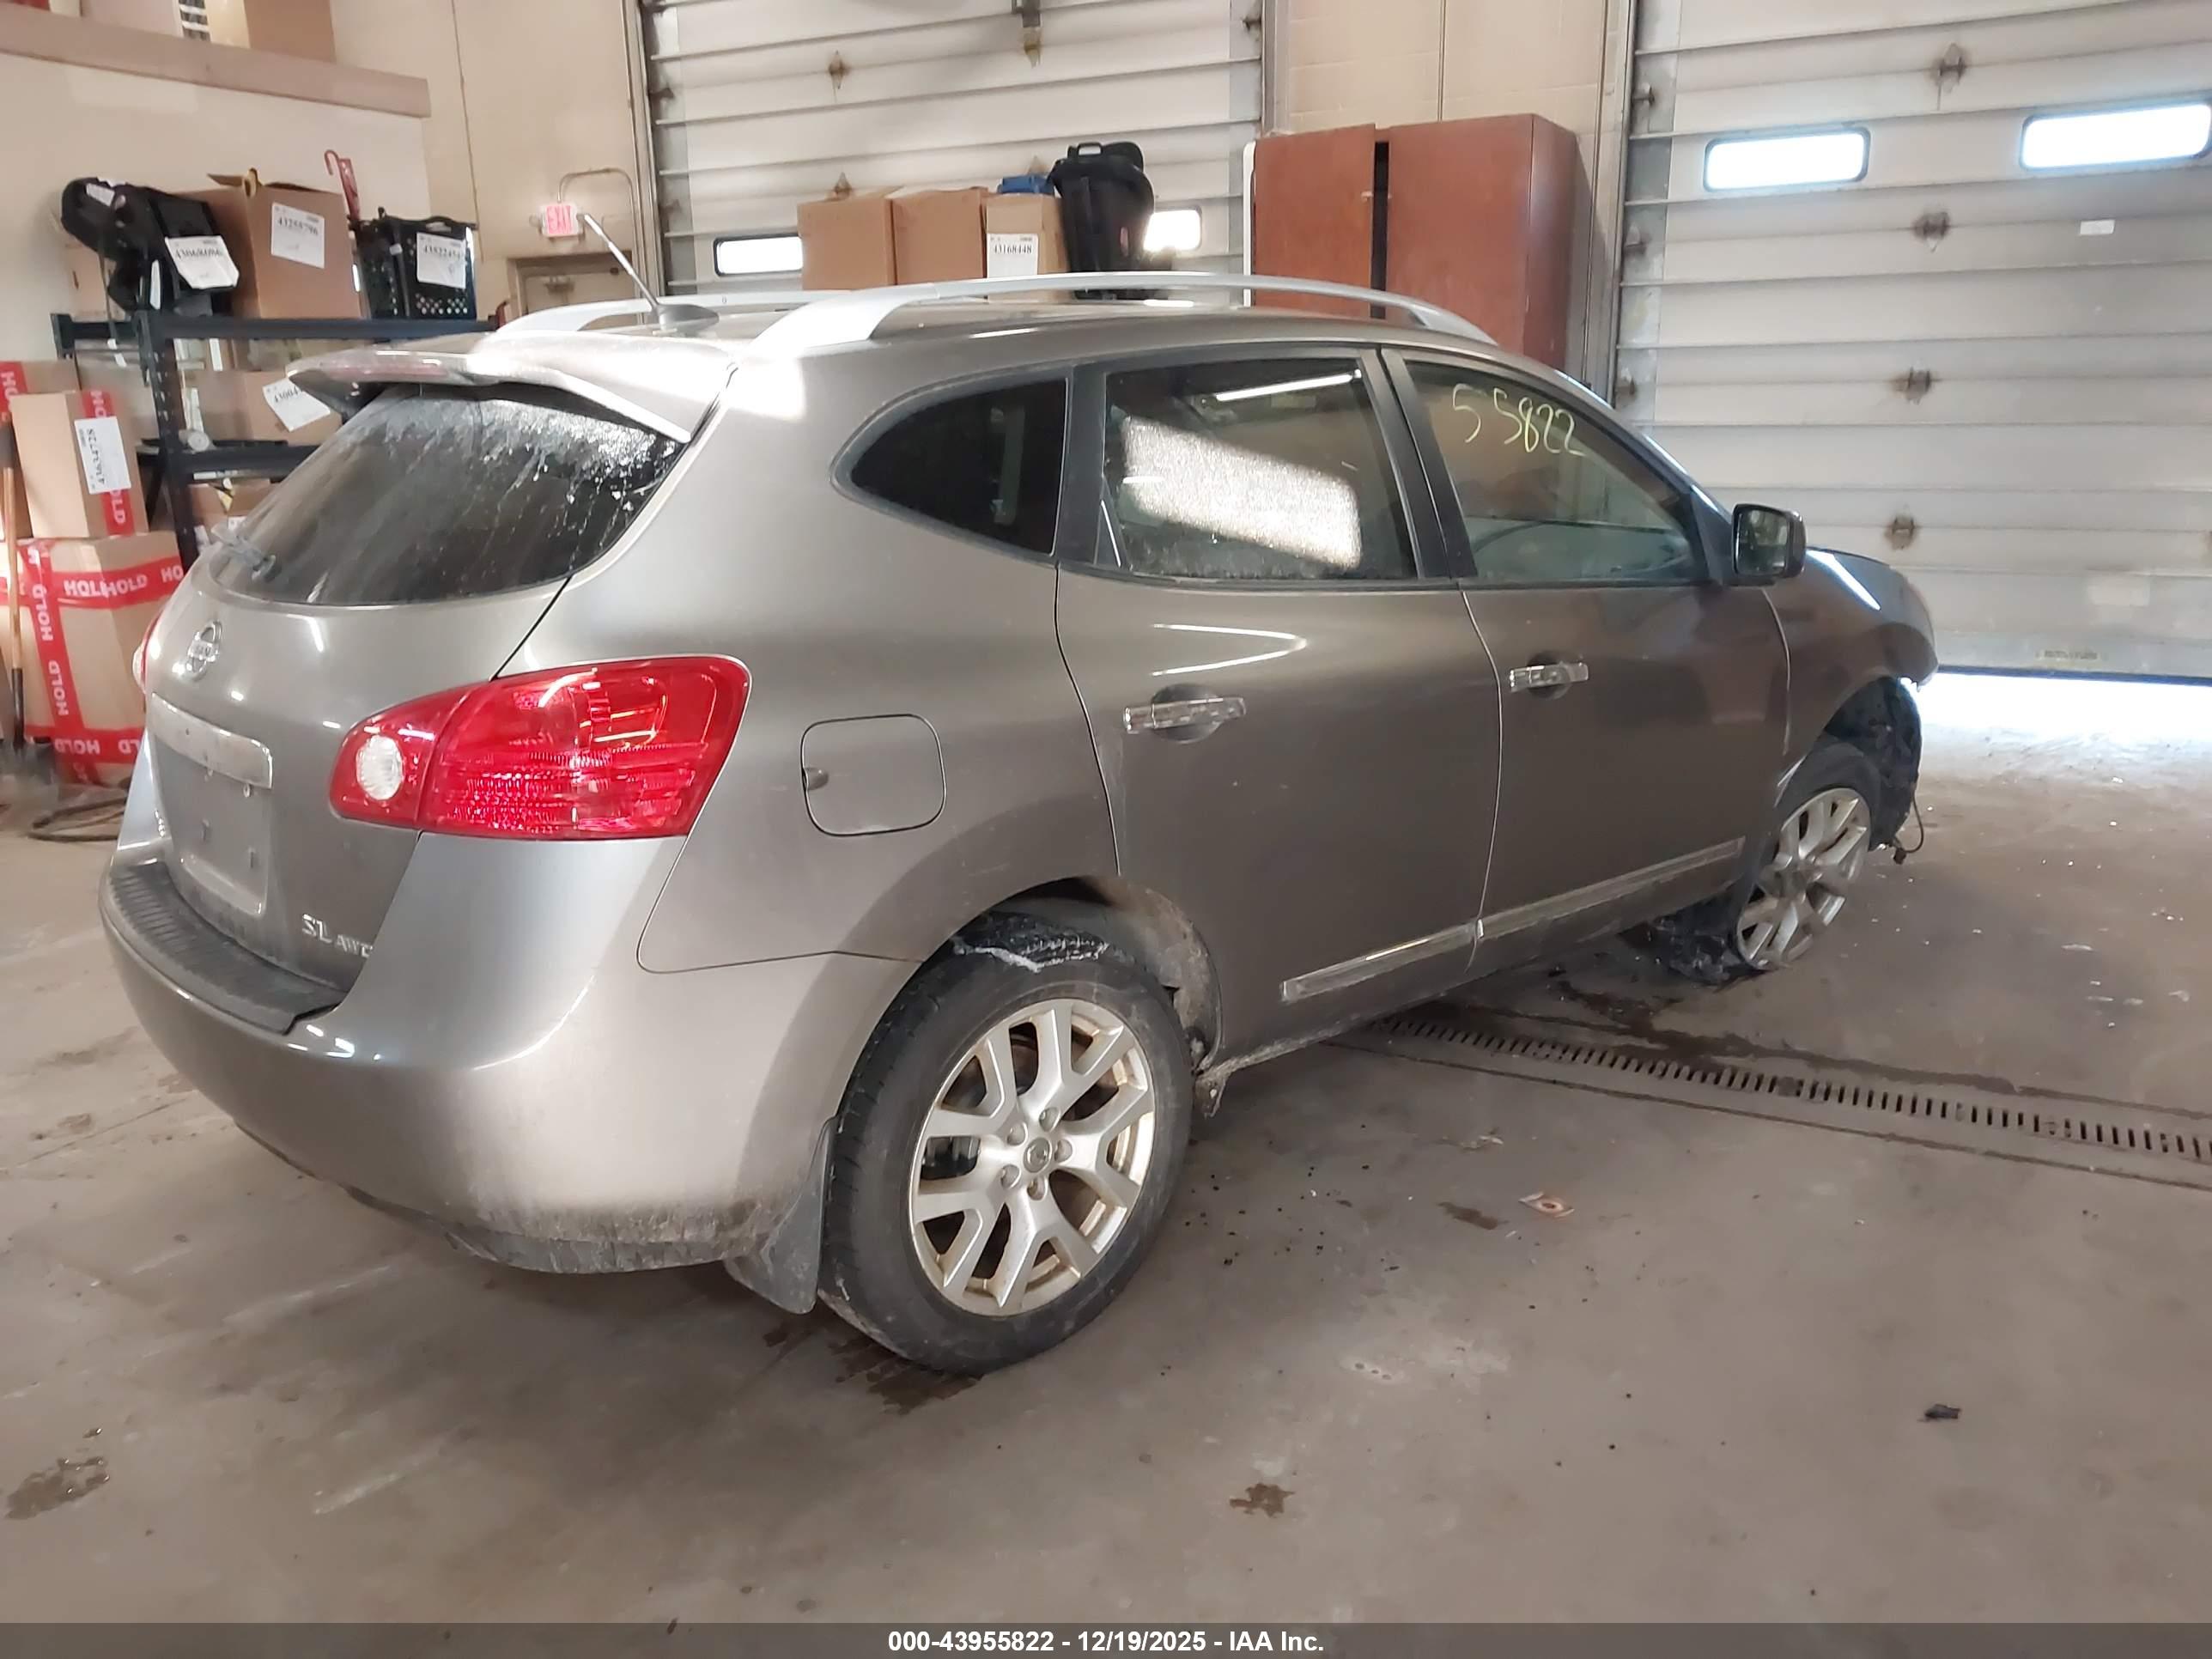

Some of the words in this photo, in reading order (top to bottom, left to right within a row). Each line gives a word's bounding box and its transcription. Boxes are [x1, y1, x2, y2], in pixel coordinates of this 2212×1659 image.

[546, 205, 572, 234] EXIT
[90, 391, 106, 419] HO
[161, 565, 184, 582] HO
[33, 584, 53, 641] HOLD
[48, 660, 69, 716] HOLD
[54, 738, 100, 755] HOLD
[118, 738, 141, 754] LD
[301, 914, 332, 944] SL
